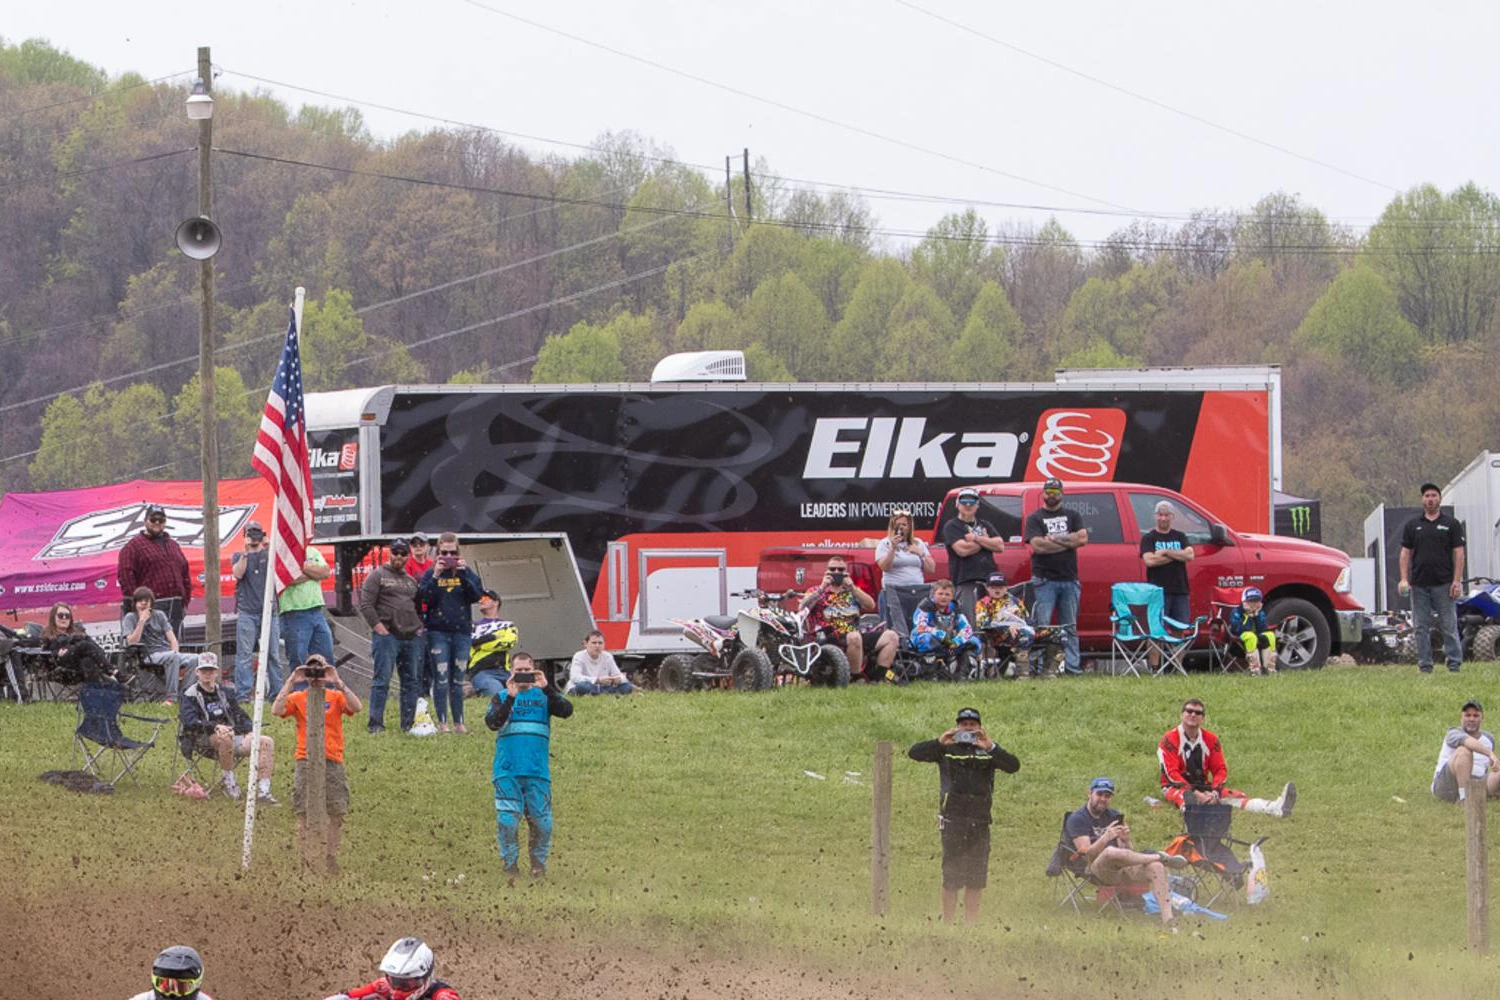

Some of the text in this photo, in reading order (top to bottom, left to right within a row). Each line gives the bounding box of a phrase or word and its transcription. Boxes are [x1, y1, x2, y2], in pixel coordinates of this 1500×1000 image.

[802, 416, 1019, 479] Elka
[801, 502, 847, 518] LEADERS
[848, 502, 860, 517] IN
[861, 502, 935, 517] POWERSPORTS
[14, 581, 87, 594] www.ssidecals.com
